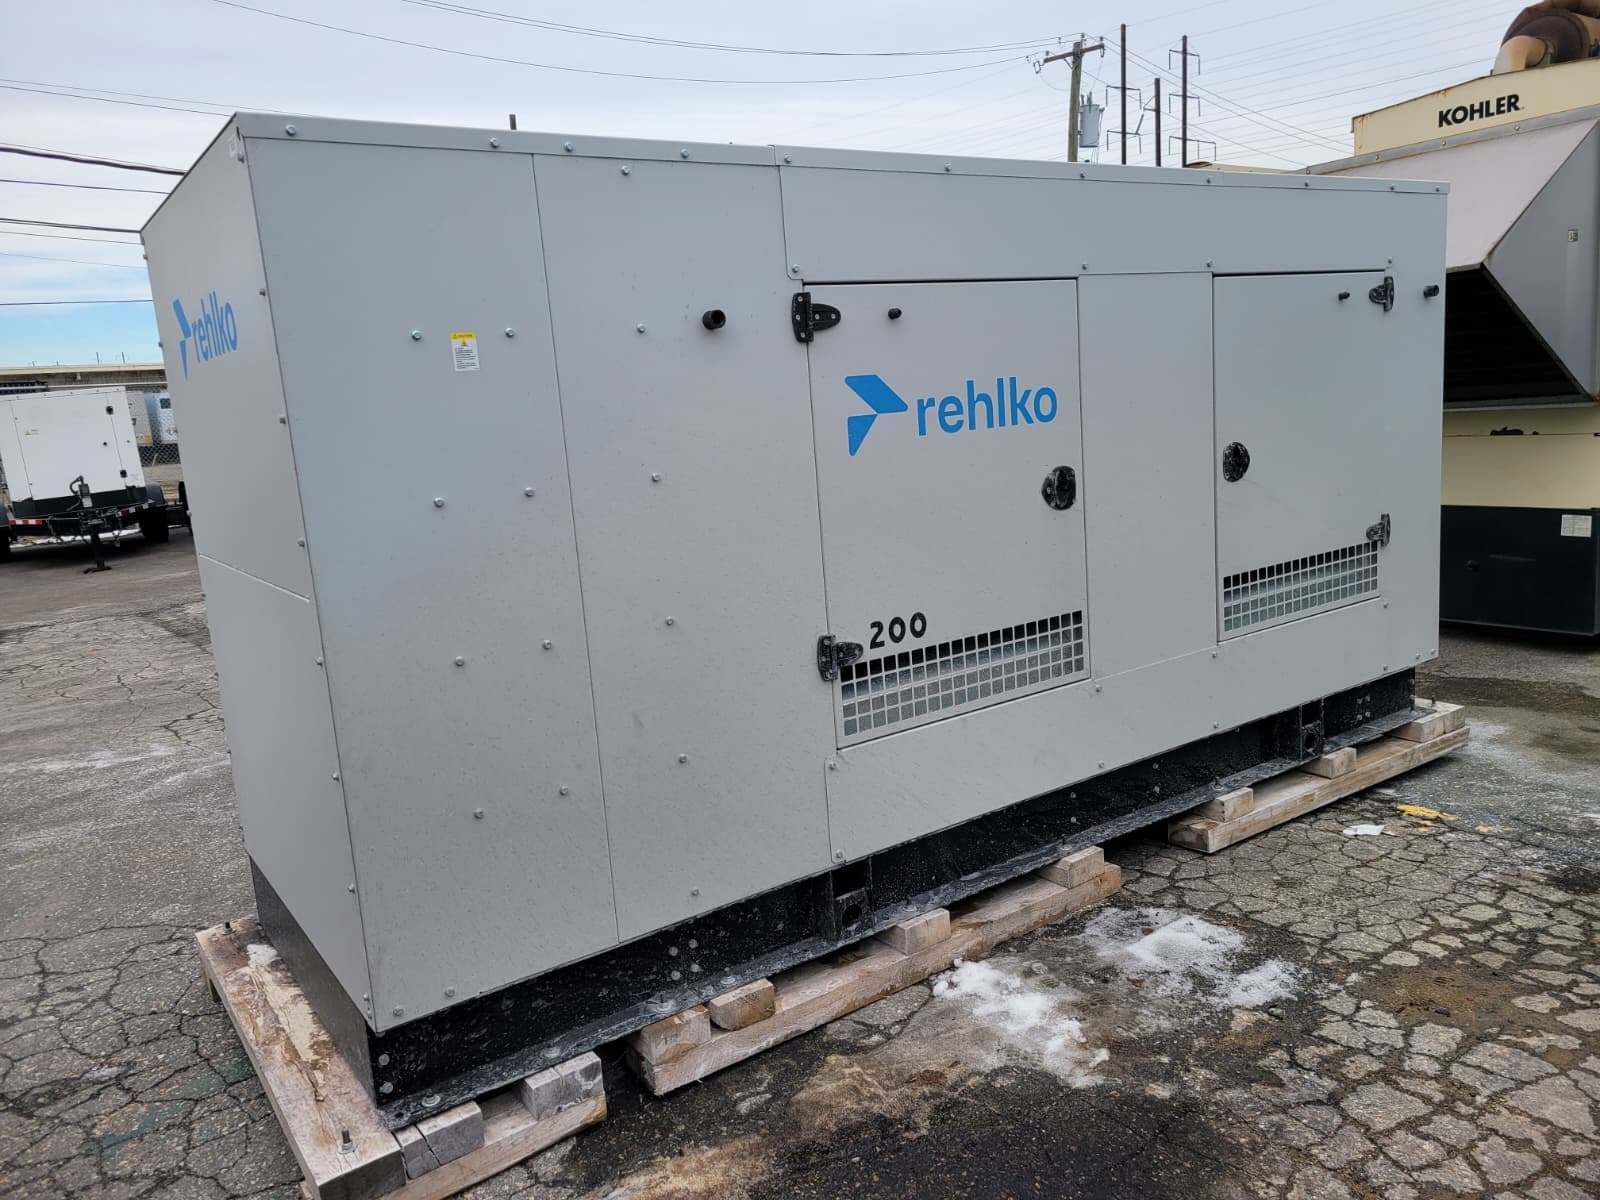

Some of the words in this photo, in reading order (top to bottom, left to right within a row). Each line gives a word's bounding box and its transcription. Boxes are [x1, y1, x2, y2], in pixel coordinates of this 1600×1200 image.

[1438, 93, 1520, 128] KOHLER
[191, 290, 238, 363] rehlko
[915, 376, 1058, 437] rehlko
[869, 611, 928, 650] 200
